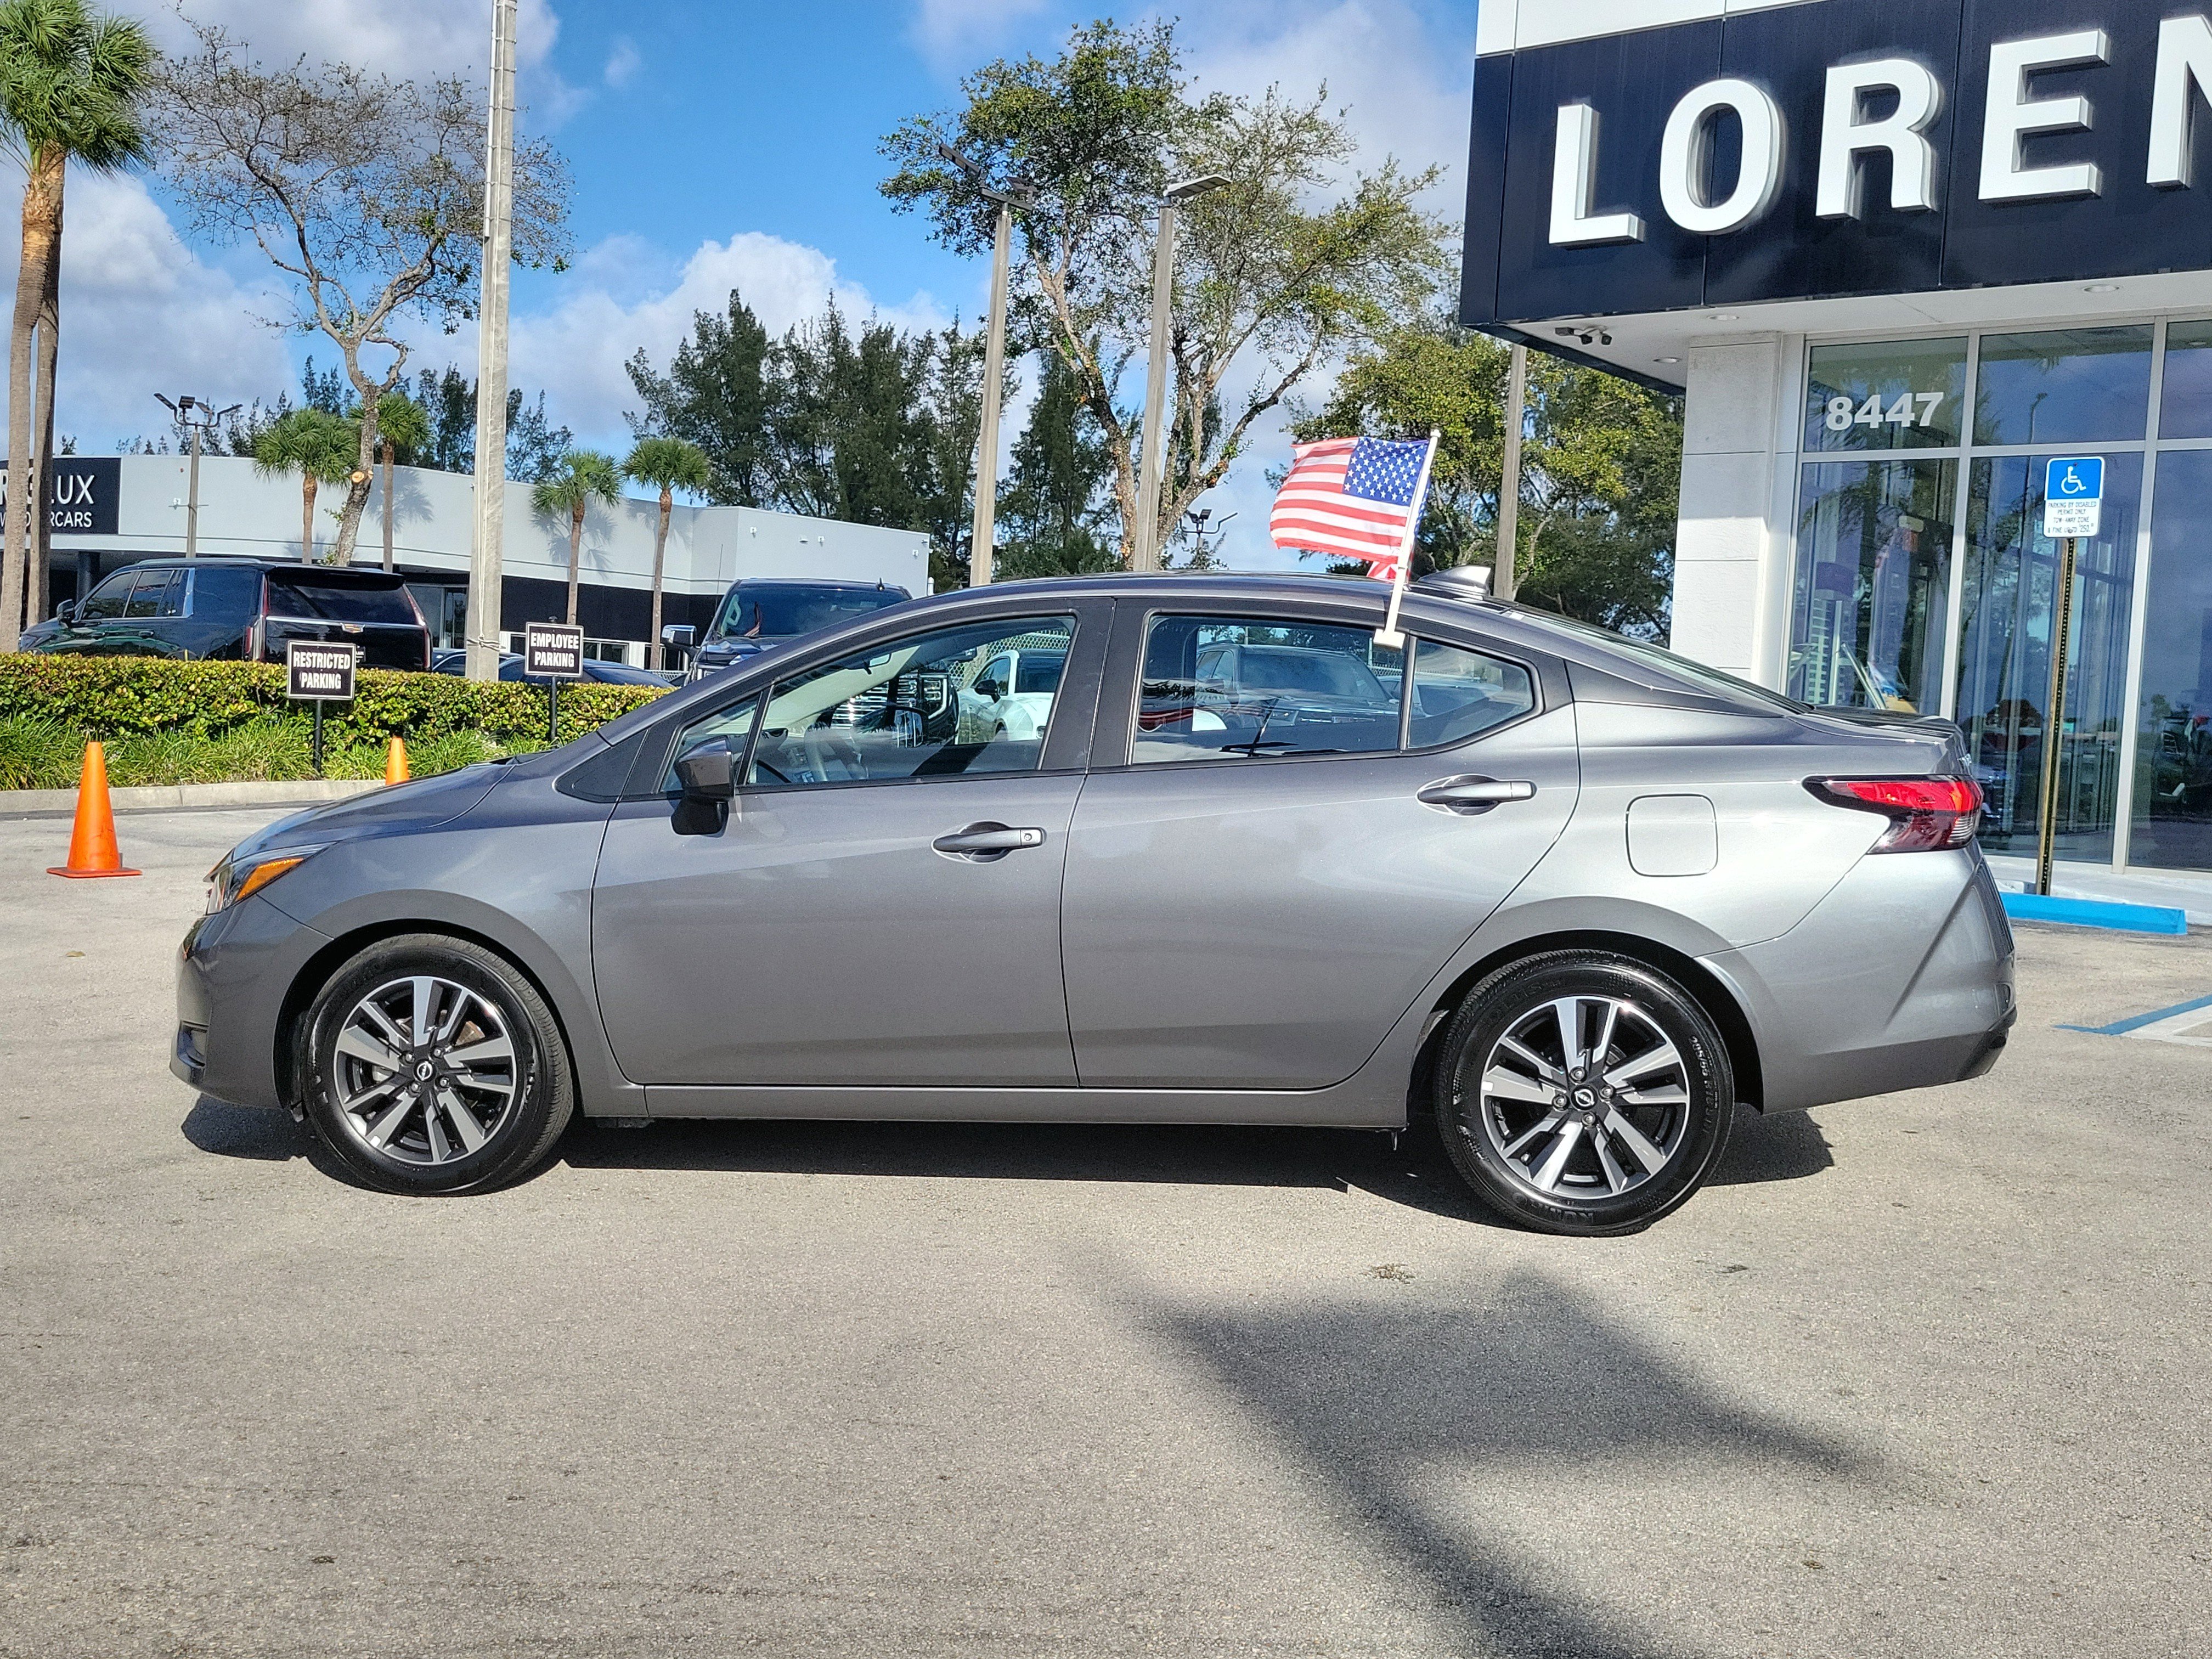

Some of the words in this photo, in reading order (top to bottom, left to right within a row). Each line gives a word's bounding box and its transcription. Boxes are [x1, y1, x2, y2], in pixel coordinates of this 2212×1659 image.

[1826, 392, 1944, 431] 8447
[530, 632, 579, 650] EMPLOYEE
[293, 651, 351, 669] RESTRICTED
[534, 651, 574, 668] PARKING
[300, 672, 342, 690] PARKING
